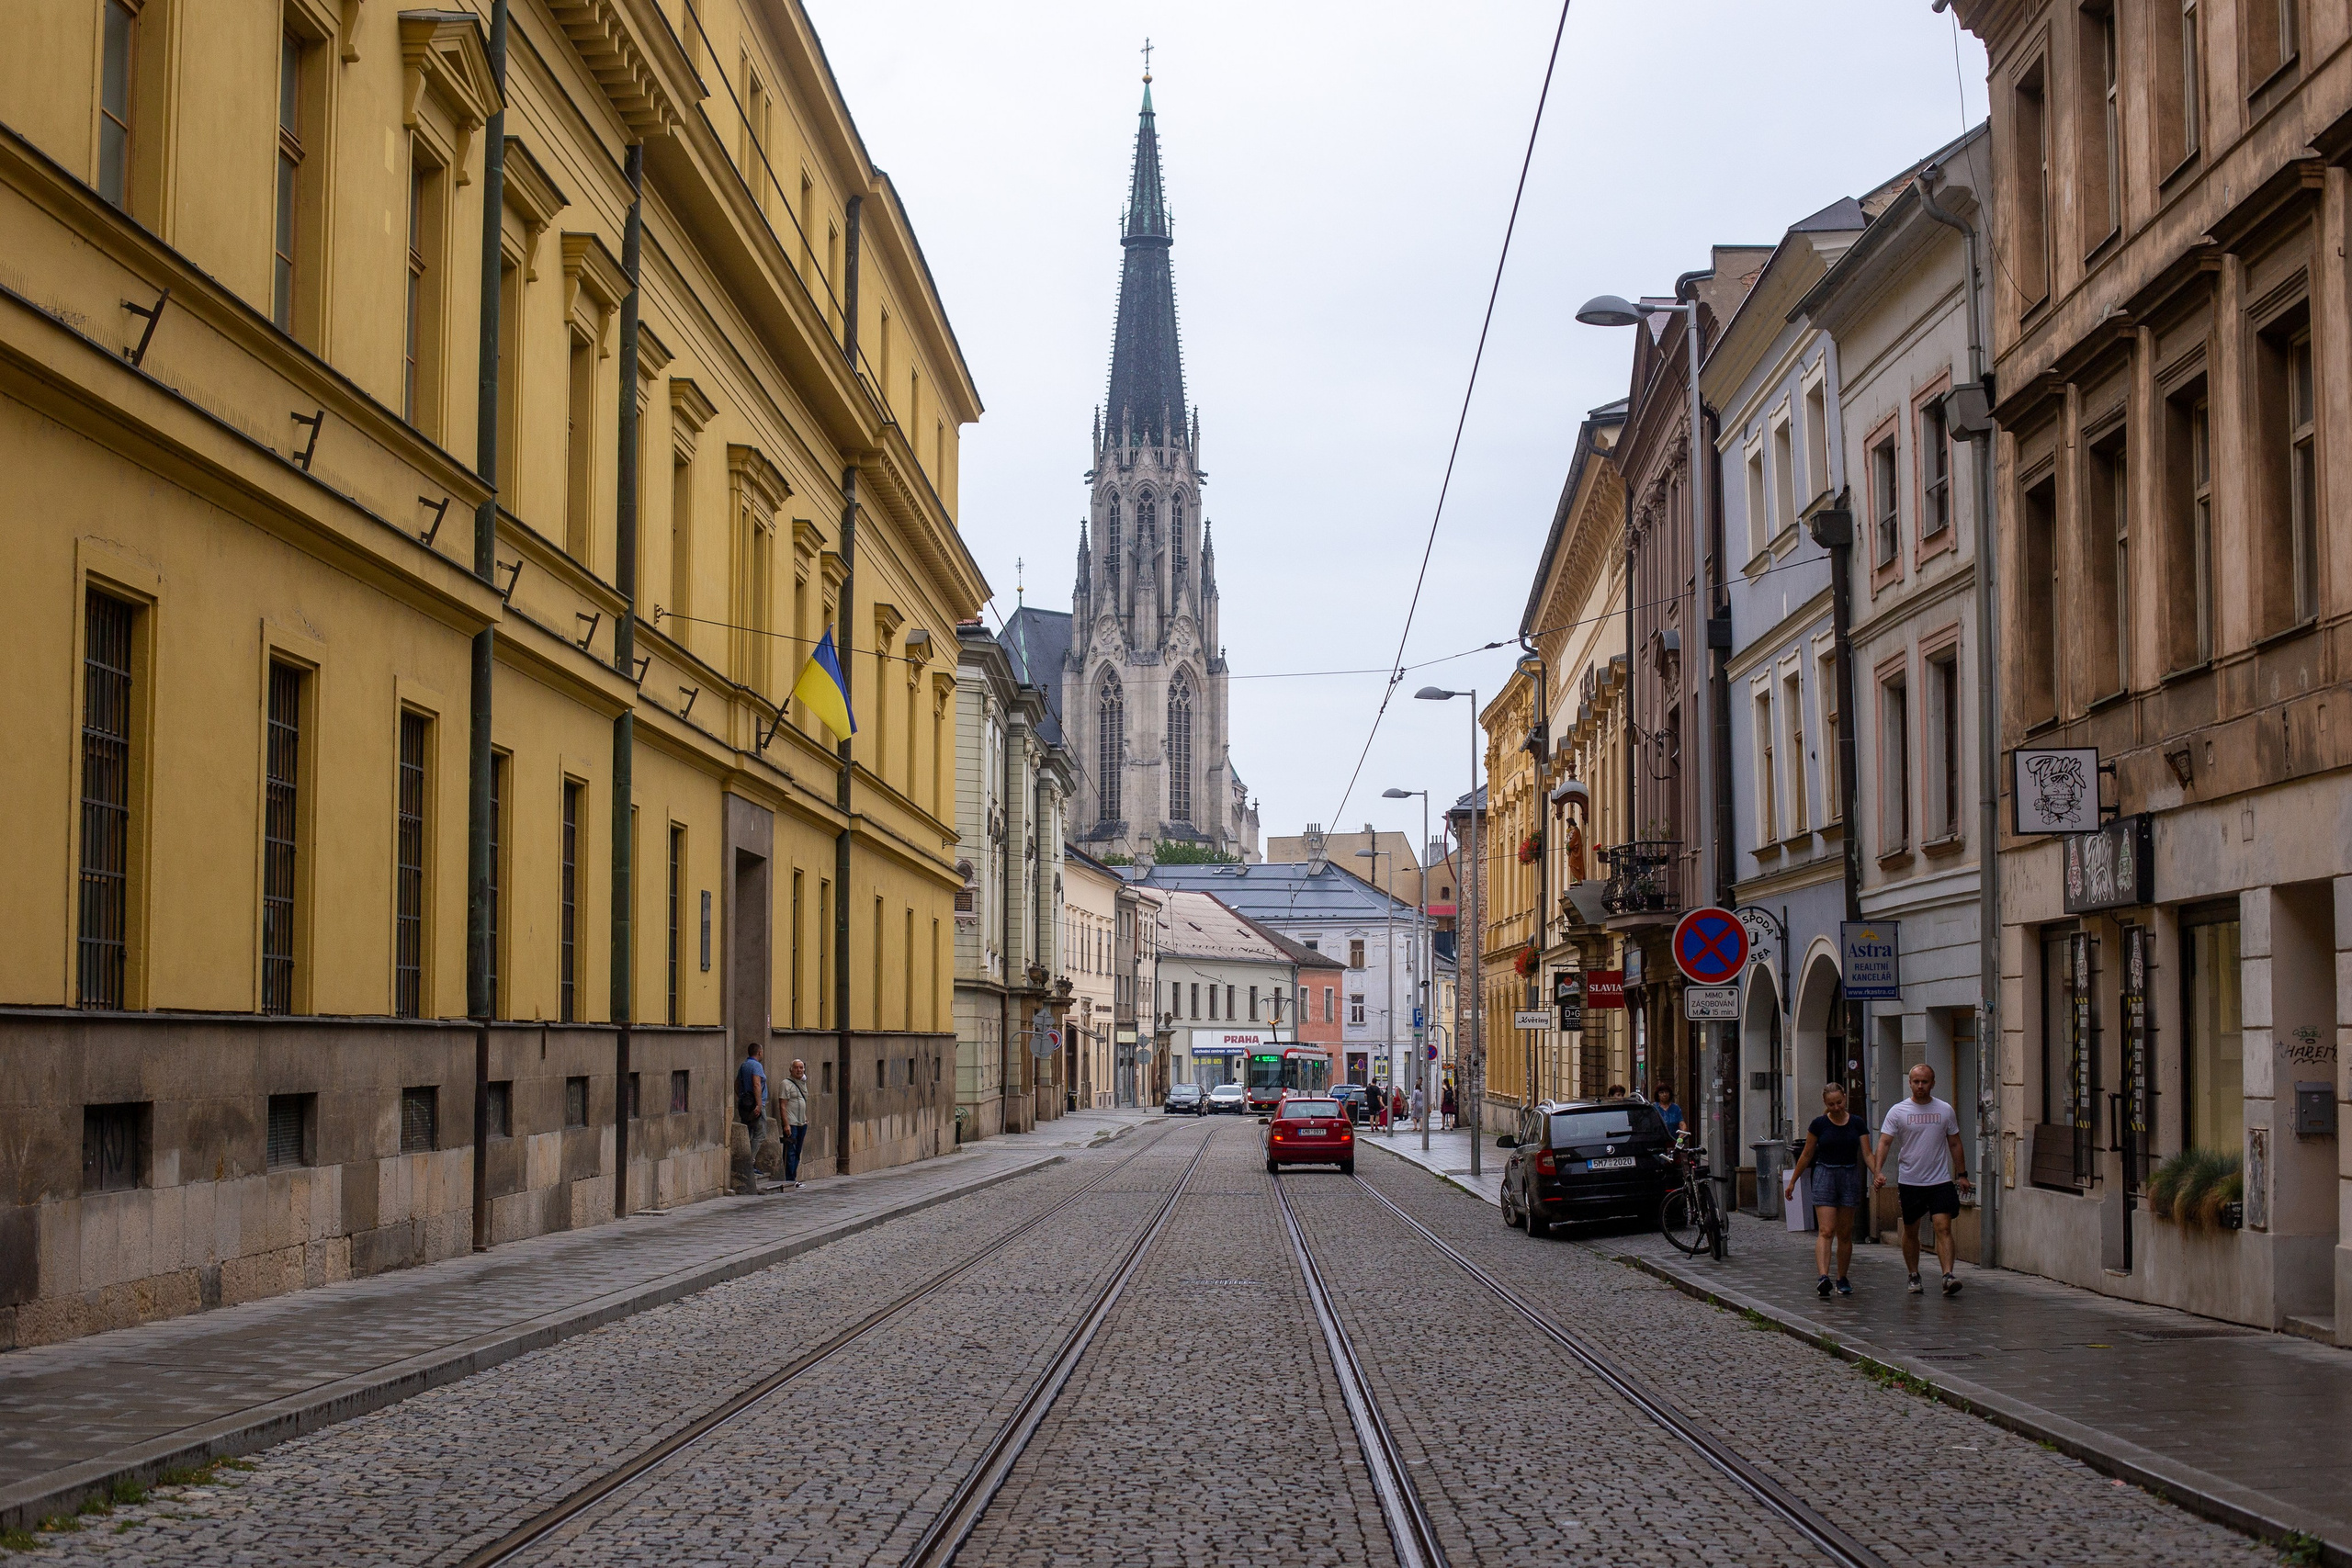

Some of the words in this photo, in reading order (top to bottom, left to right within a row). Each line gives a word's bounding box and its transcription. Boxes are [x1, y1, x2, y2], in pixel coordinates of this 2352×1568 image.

[1742, 914, 1774, 936] SPODA
[1750, 947, 1771, 962] SEA
[1848, 942, 1892, 958] Astra
[1854, 961, 1889, 971] REALITNÍ
[1852, 971, 1892, 982] KANCELÁŘ
[1589, 984, 1623, 992] SLAVIA
[1691, 999, 1735, 1008] ZÁSOBOVÁNÍ
[1518, 1016, 1549, 1024] Květiny
[1224, 1035, 1260, 1043] PRAHA
[1907, 1112, 1942, 1125] PUMA
